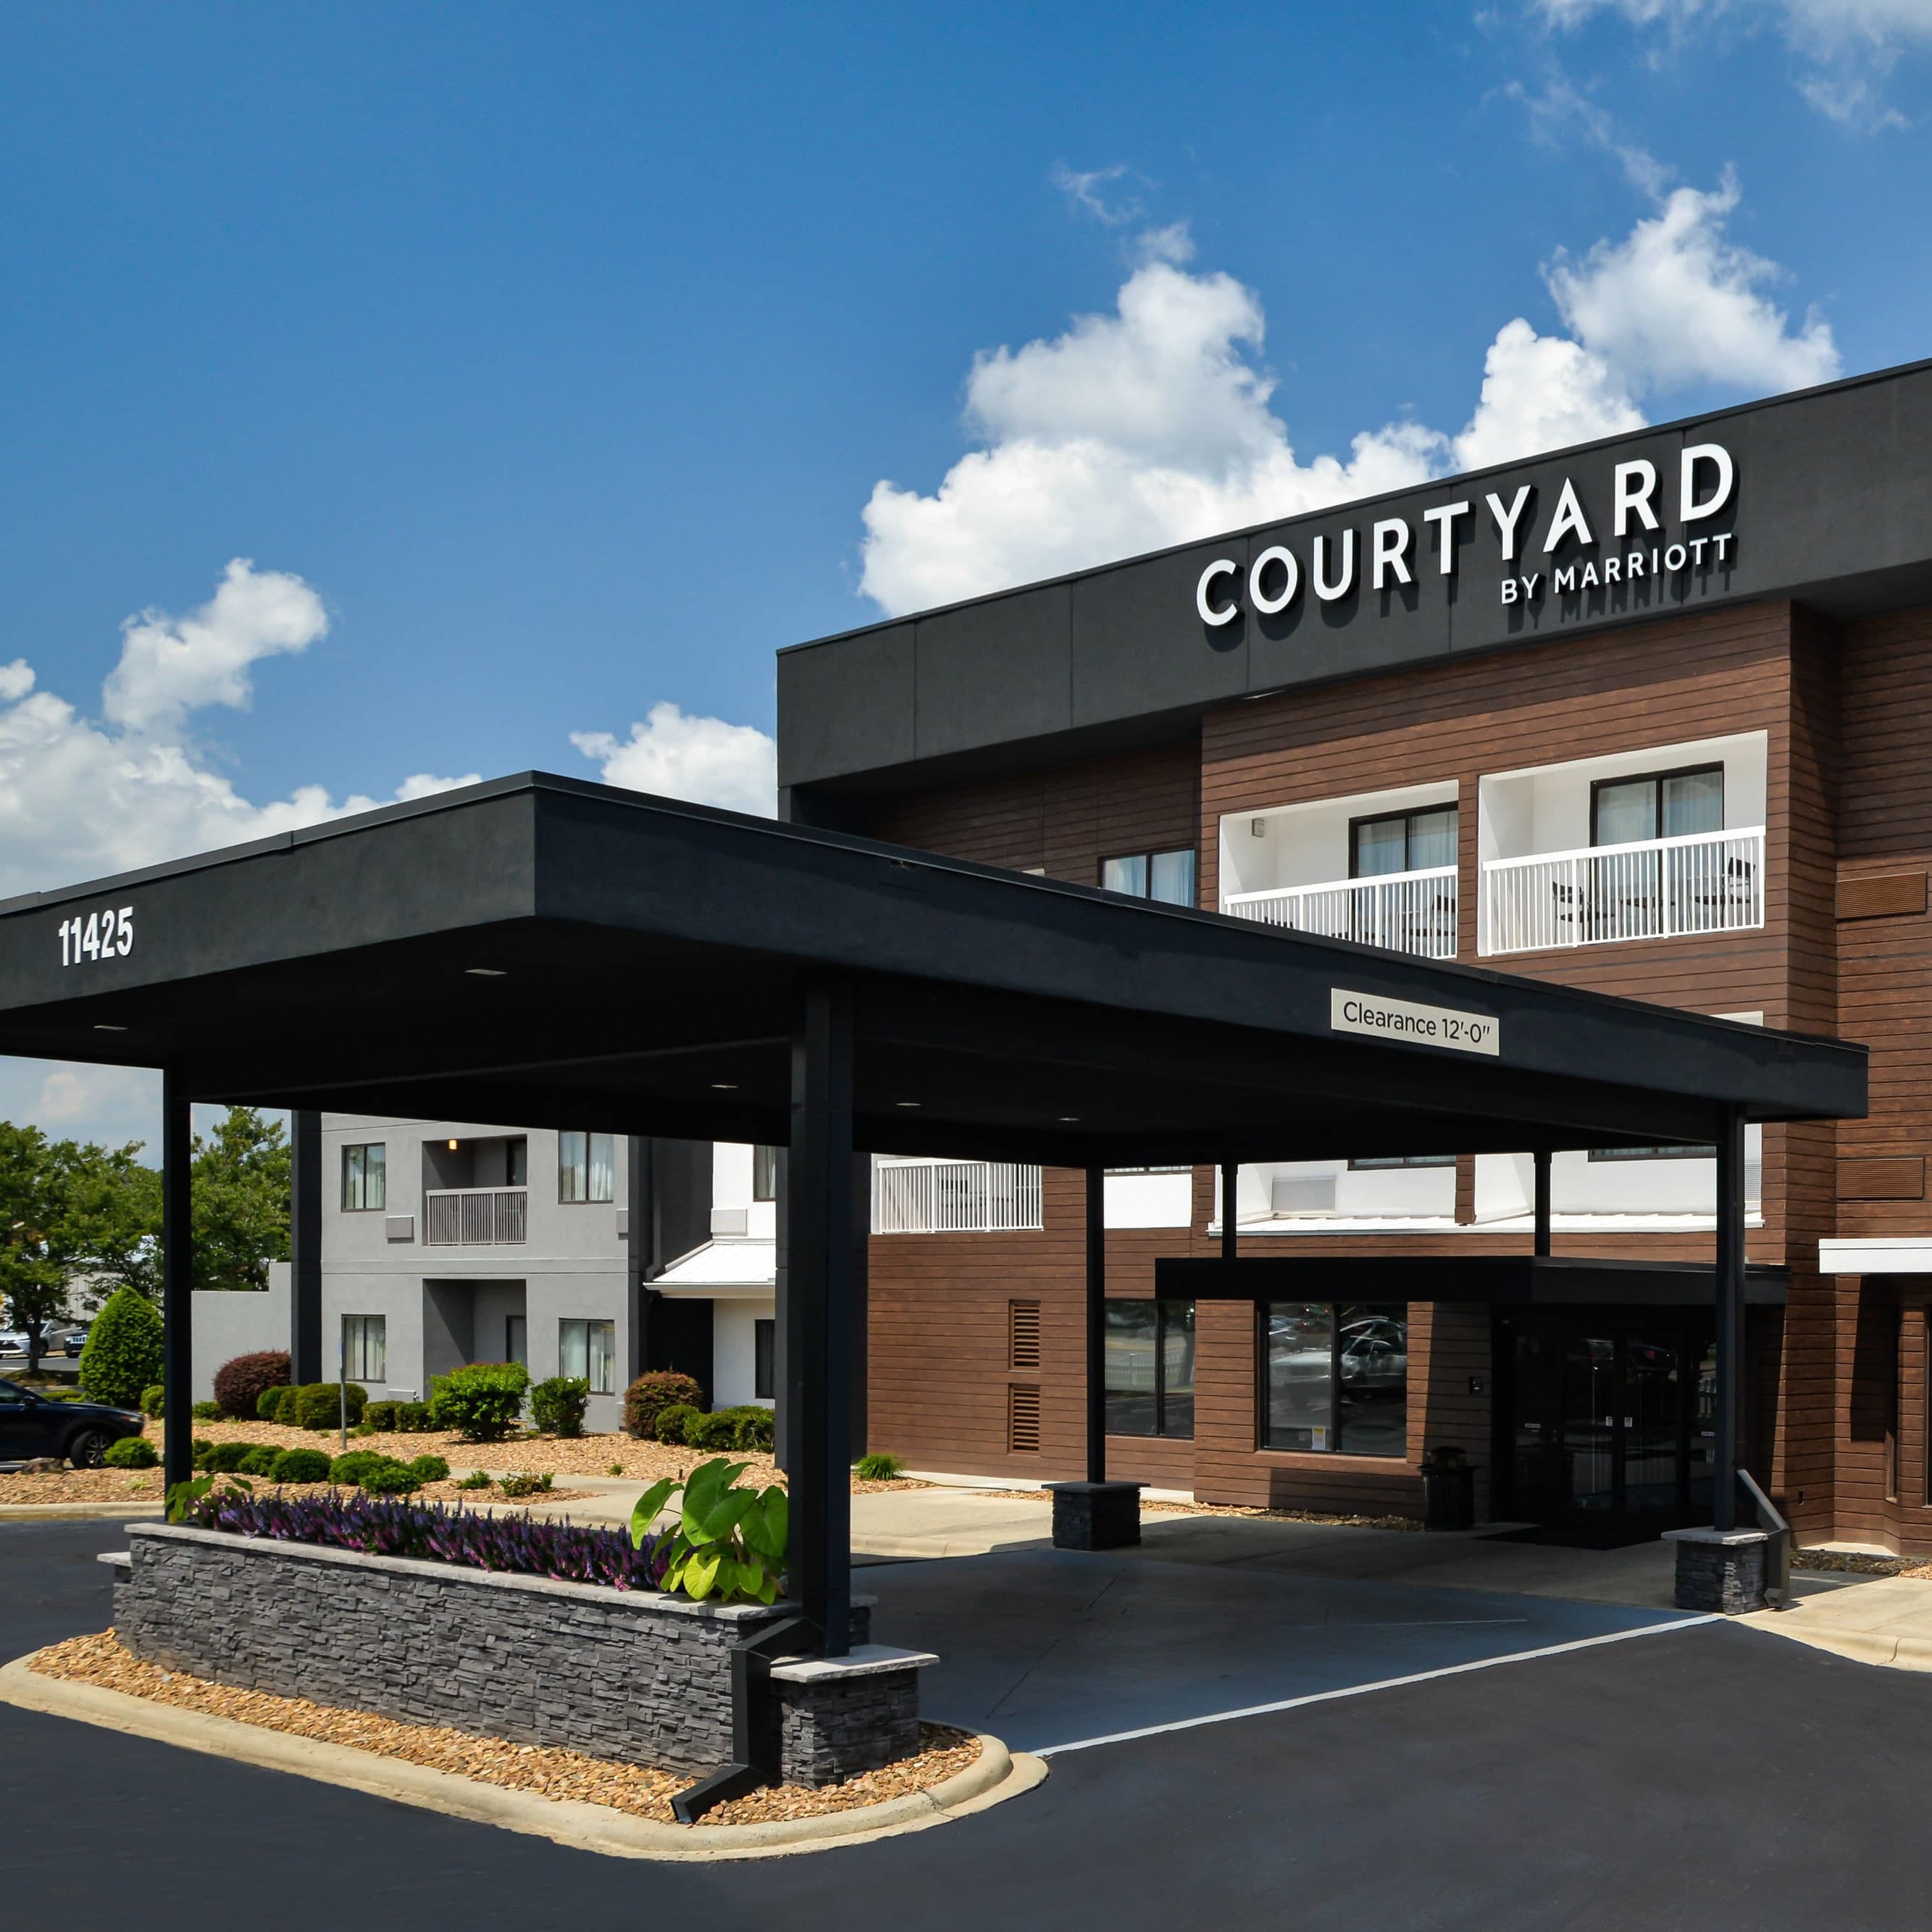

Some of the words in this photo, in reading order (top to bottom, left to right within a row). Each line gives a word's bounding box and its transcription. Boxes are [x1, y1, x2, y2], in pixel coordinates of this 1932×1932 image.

[1196, 443, 1733, 627] COURTYARD
[1501, 573, 1539, 604] BY
[1554, 532, 1732, 594] MARRIOTT
[58, 906, 133, 966] 11425
[1343, 1001, 1437, 1036] Clearance
